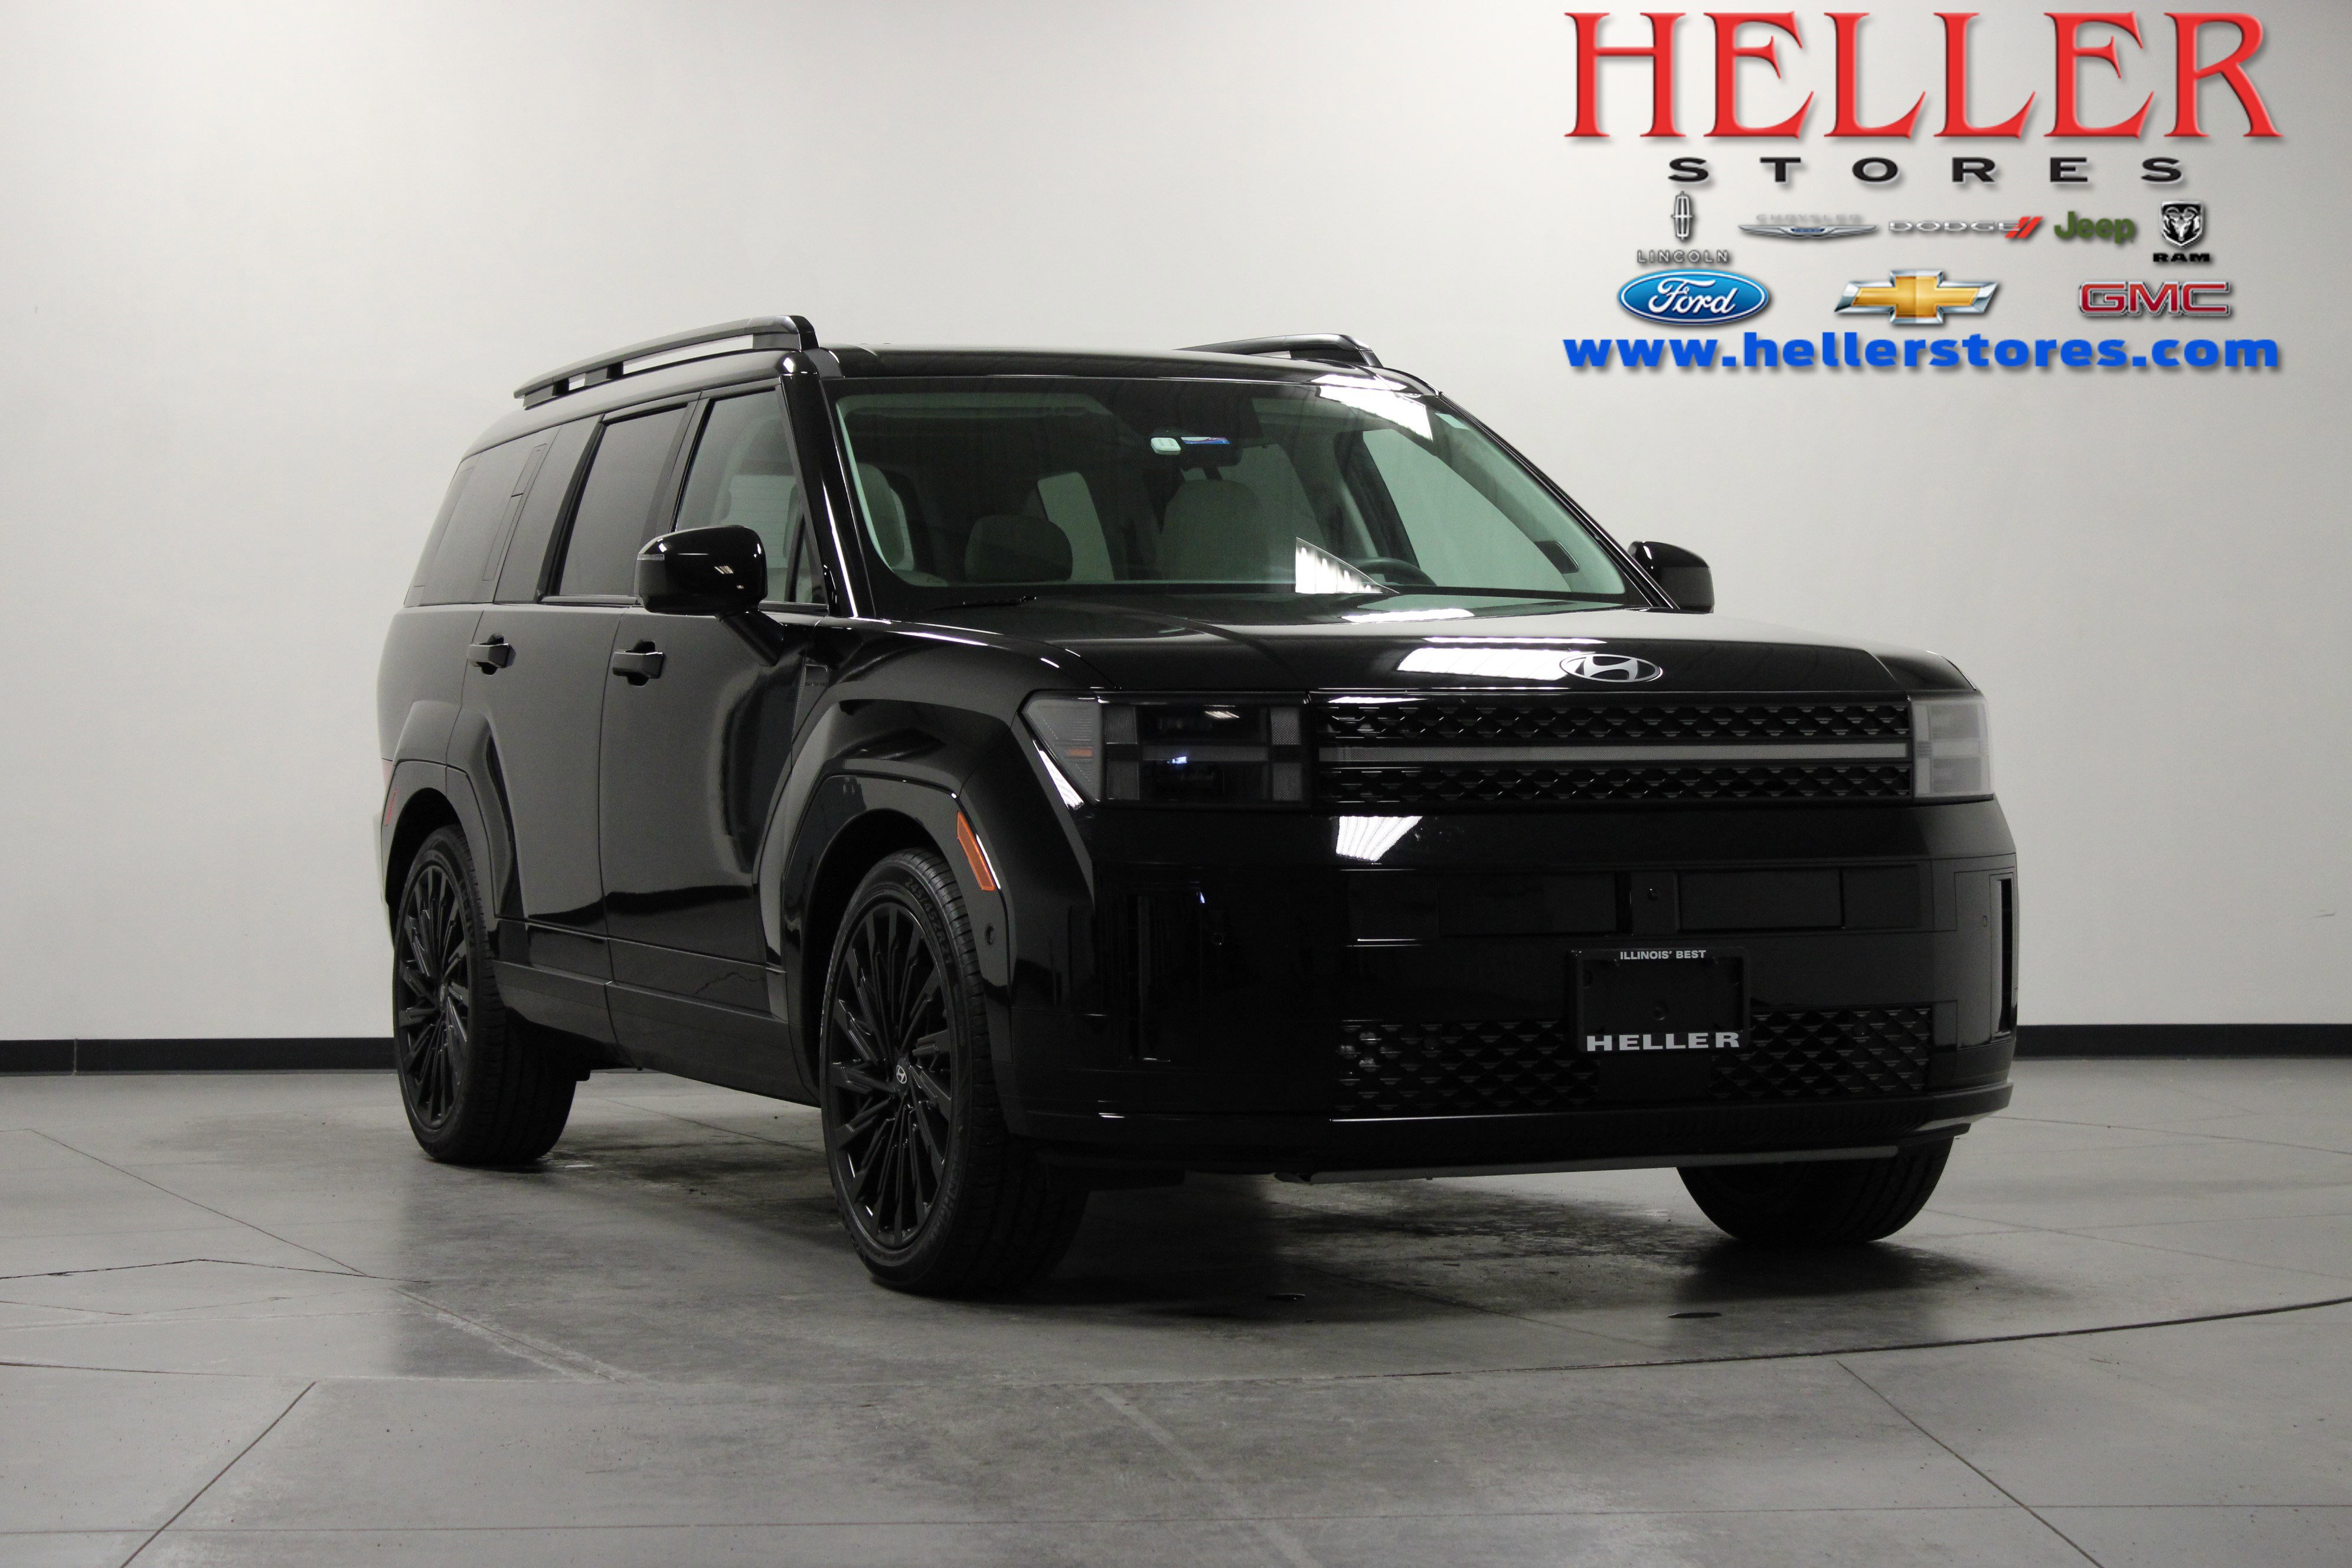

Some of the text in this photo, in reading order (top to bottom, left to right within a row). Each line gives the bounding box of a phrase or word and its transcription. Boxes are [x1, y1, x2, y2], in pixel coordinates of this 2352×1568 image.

[1620, 949, 1707, 960] ILLINOIS' BEST
[1586, 1032, 1739, 1052] HELLER
